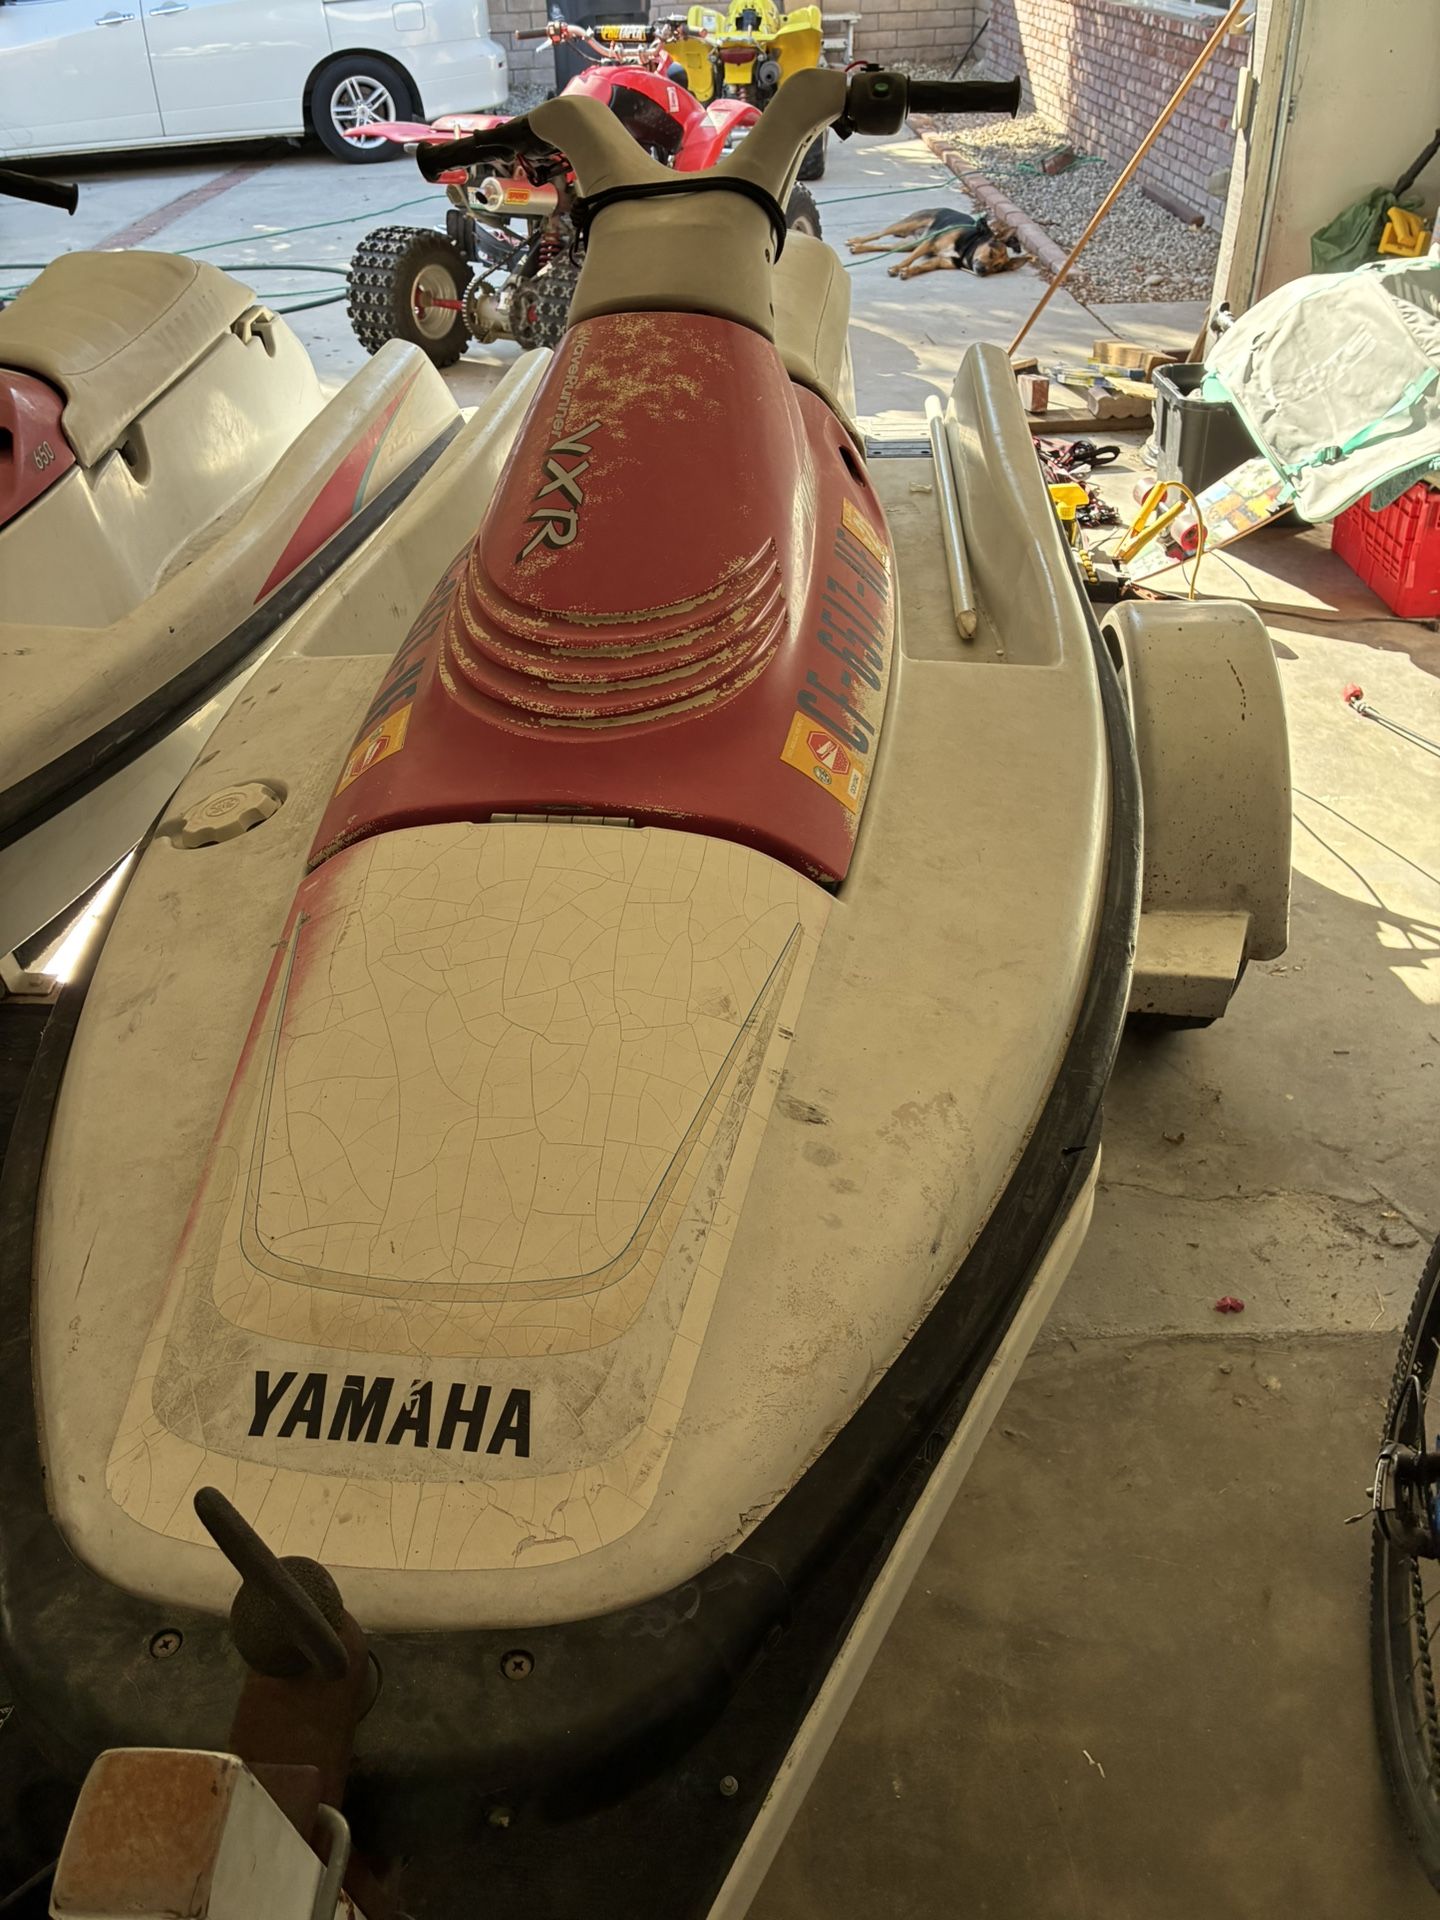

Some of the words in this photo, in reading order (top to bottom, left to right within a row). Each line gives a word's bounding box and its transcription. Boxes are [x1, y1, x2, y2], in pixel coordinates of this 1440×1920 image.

[33, 440, 55, 470] 650
[514, 420, 602, 564] VXR
[248, 1370, 531, 1458] YAMAHA
